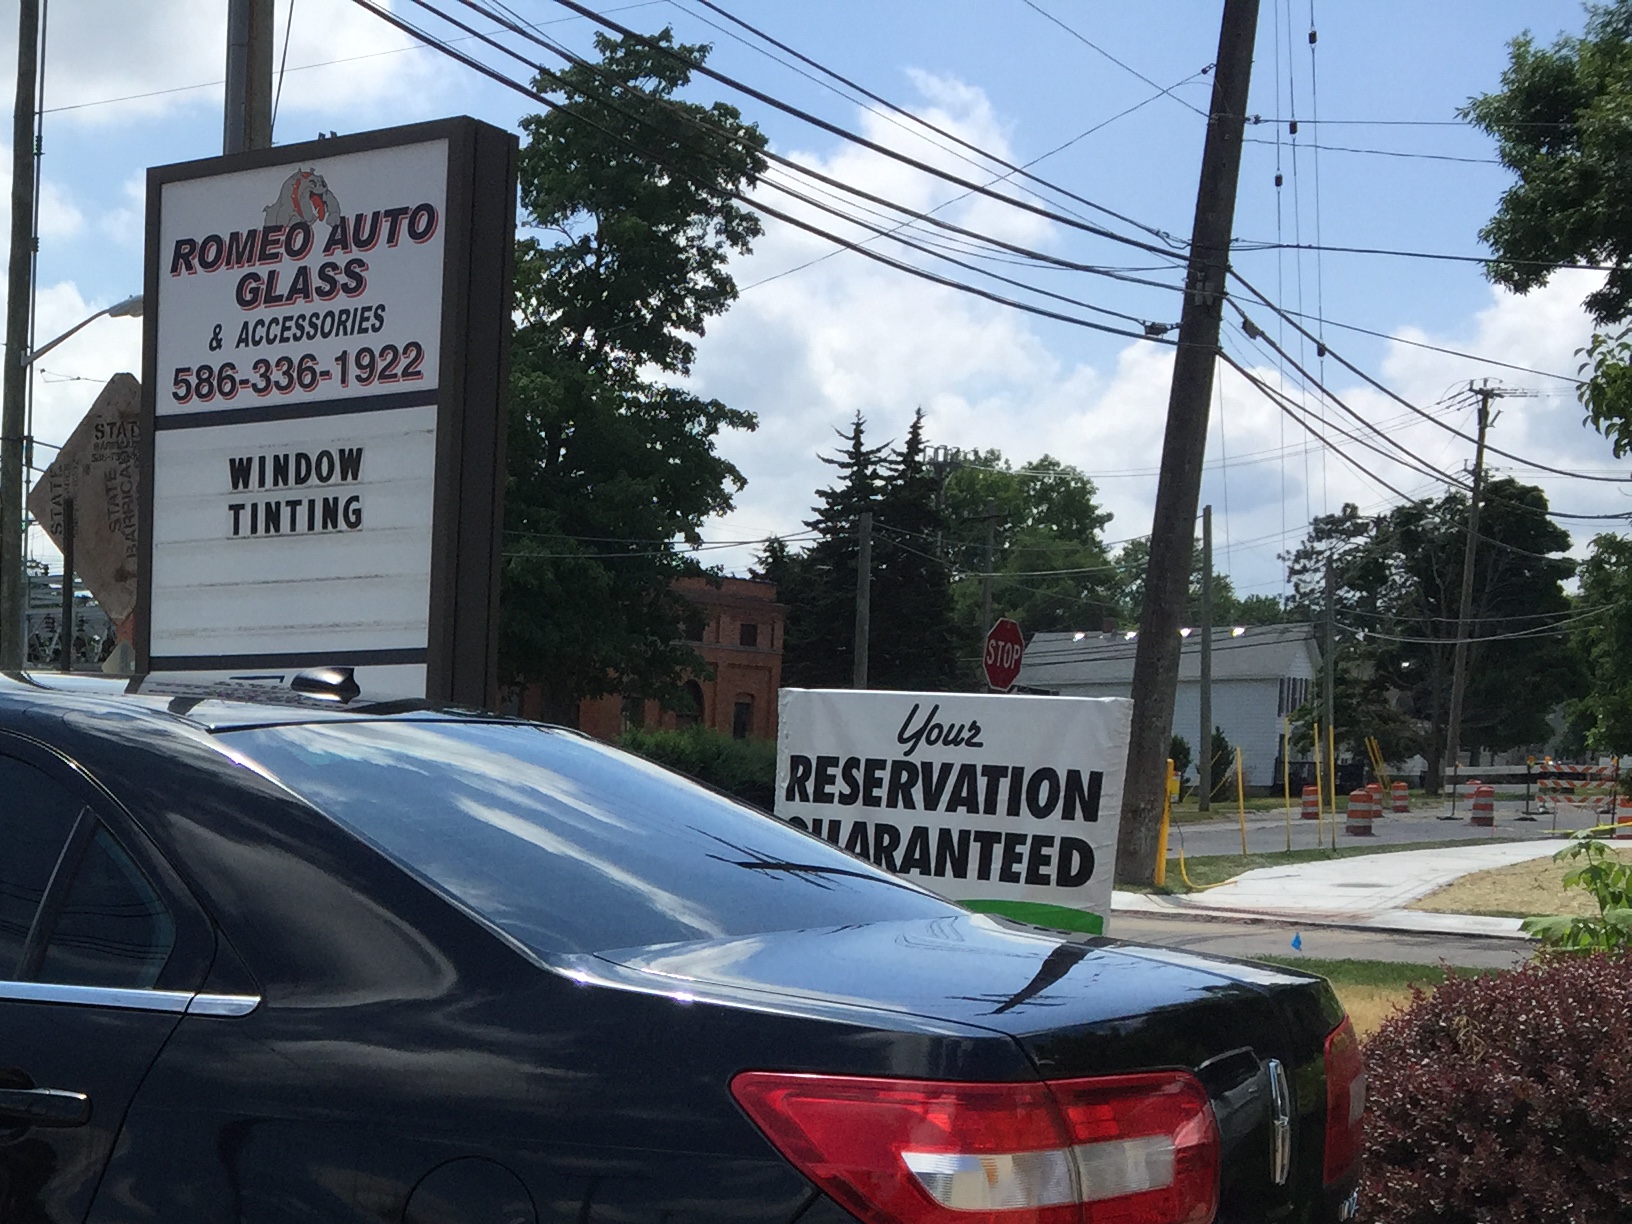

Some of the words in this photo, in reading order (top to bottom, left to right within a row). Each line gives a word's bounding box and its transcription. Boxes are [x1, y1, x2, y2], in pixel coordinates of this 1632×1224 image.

[170, 221, 314, 277] ROMEO
[323, 203, 439, 257] AUTO
[235, 258, 369, 311] GLASS
[208, 323, 223, 351] &
[235, 304, 386, 349] ACCESSORIES
[171, 341, 424, 404] 586-336-1922
[229, 447, 364, 490] WINDOW
[228, 495, 362, 536] TINTING
[986, 639, 1021, 670] STOP
[897, 703, 984, 757] Your
[785, 755, 1104, 823] RESERVATION
